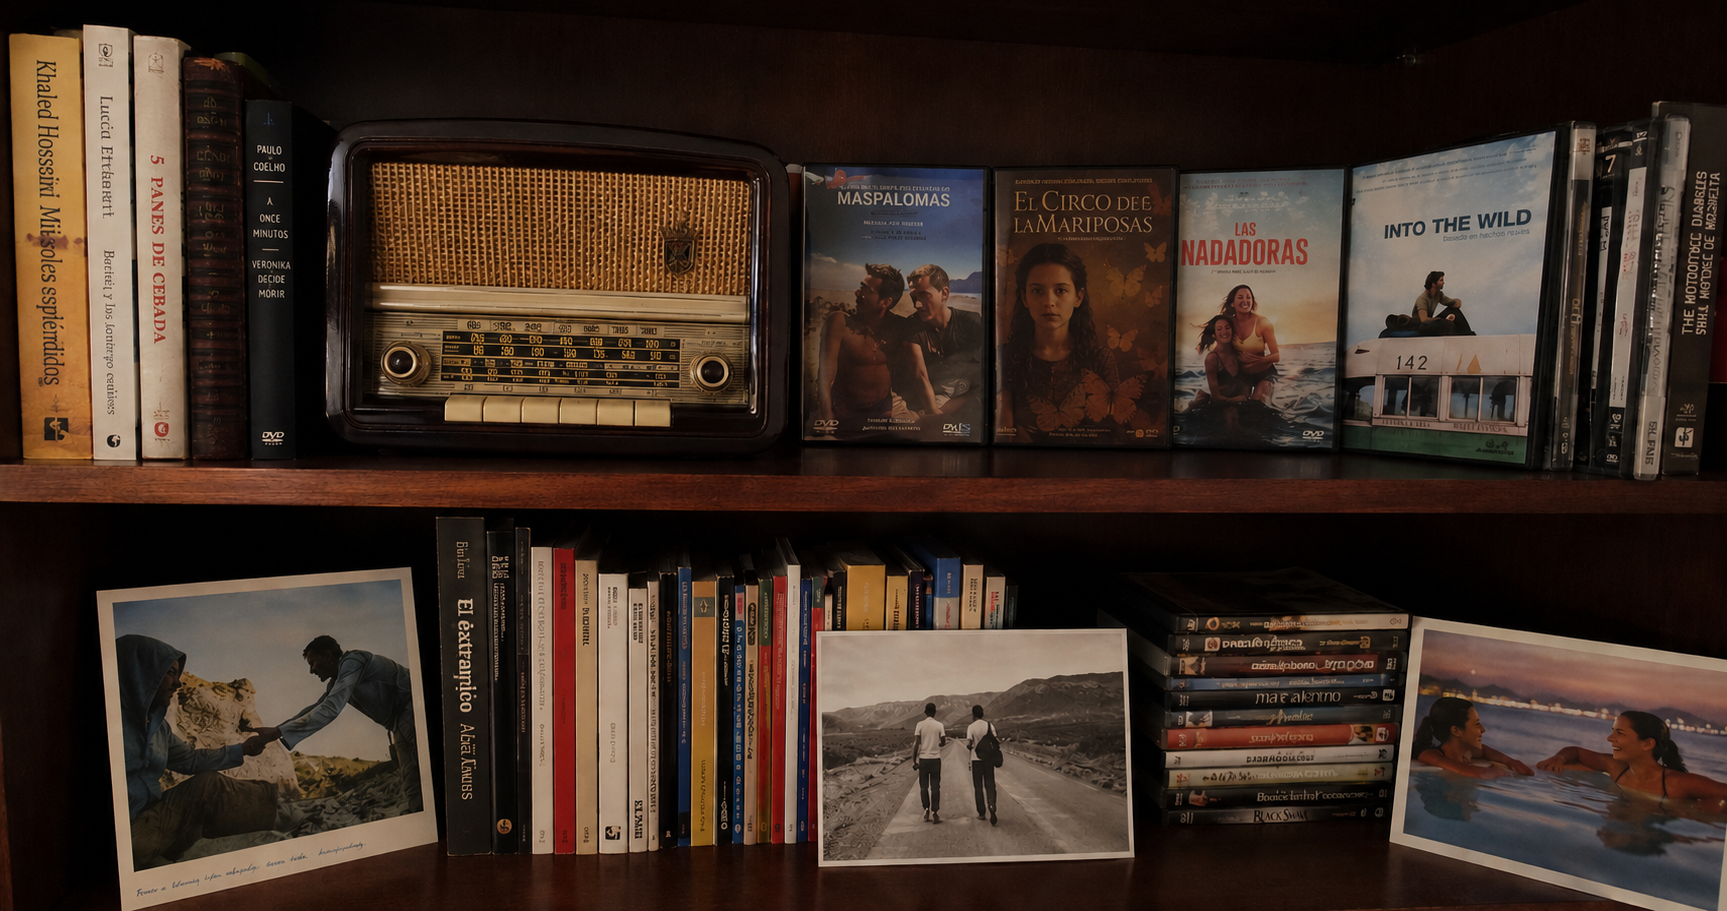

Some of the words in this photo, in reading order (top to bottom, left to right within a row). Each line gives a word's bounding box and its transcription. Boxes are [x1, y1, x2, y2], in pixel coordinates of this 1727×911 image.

[36, 60, 59, 120] Khaled
[256, 144, 282, 156] PAULO
[150, 154, 165, 166] 5
[253, 161, 286, 173] COELHO
[150, 176, 165, 235] PANES
[837, 191, 950, 207] MASPALOMAS
[1014, 190, 1038, 212] EL
[1042, 190, 1112, 212] CIRCO
[259, 213, 281, 224] ONCE
[1384, 220, 1426, 240] INTO
[1432, 215, 1471, 234] THE
[1477, 208, 1532, 230] WILD
[252, 229, 289, 239] MINUTOS
[1234, 222, 1257, 236] LAS
[151, 241, 165, 267] DE
[1181, 238, 1309, 266] NADADORAS
[251, 260, 291, 270] VERONIKA
[257, 274, 286, 284] DECIDE
[258, 289, 285, 299] MORIR
[152, 272, 166, 344] CEBADA
[1681, 308, 1695, 335] THE
[1396, 355, 1428, 371] 142
[813, 419, 839, 430] DVD
[262, 431, 285, 442] DVD
[1302, 430, 1325, 440] DVD
[1253, 810, 1282, 823] BLACK
